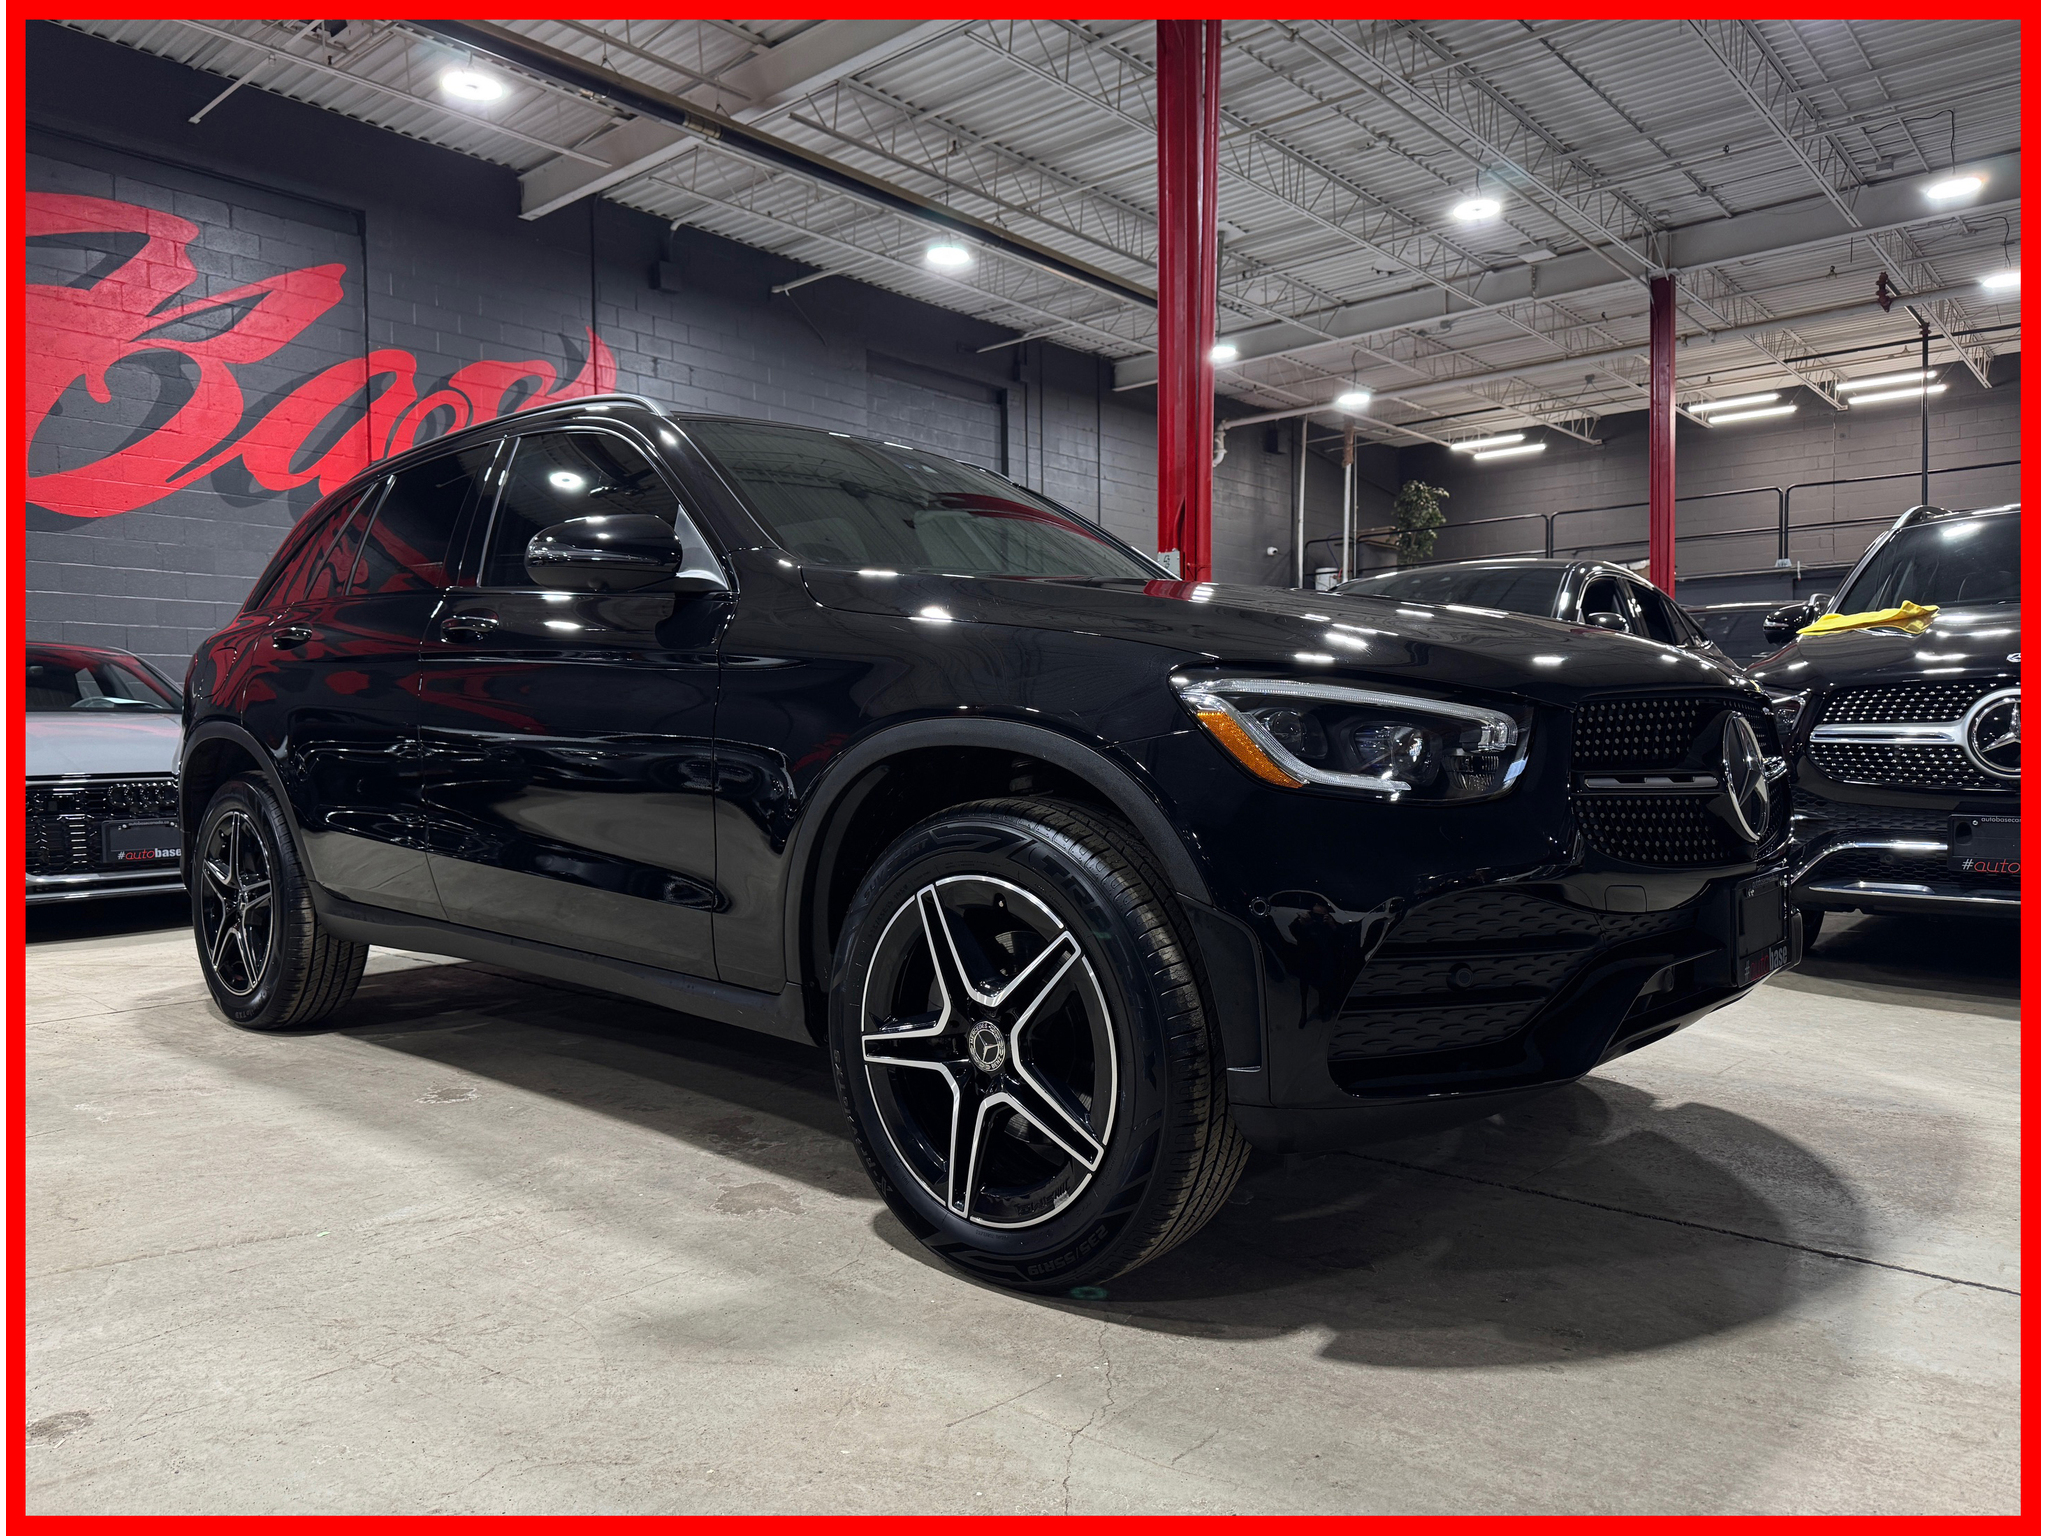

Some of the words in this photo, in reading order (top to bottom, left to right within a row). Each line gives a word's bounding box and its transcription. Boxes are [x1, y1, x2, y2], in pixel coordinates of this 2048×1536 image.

[117, 847, 182, 861] #autobase
[1961, 858, 2021, 874] #auto
[1744, 945, 1788, 983] #autobase
[1026, 1224, 1109, 1277] 235/55R19
